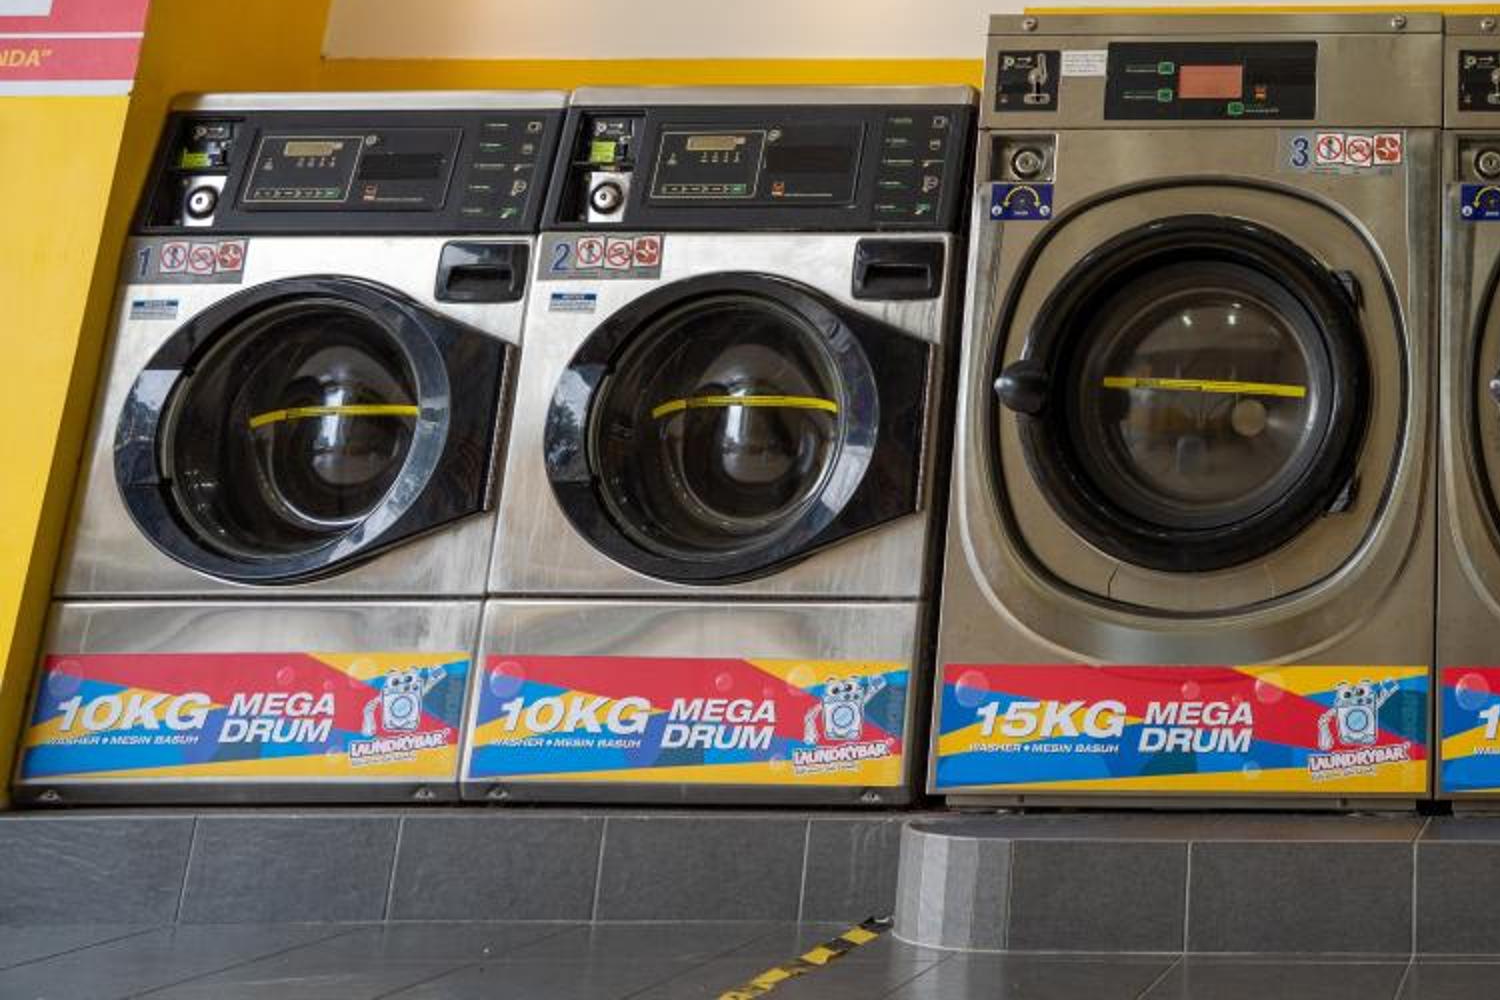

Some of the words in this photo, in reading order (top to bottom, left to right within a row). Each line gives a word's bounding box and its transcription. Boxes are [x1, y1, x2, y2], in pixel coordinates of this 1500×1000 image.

[1291, 137, 1310, 168] 3
[138, 247, 152, 276] 1
[551, 243, 570, 273] 2
[58, 693, 211, 732] 10KG
[229, 693, 336, 716] MEGA
[977, 700, 1127, 738] 15KG
[1145, 702, 1253, 726] MEGA
[219, 718, 335, 743] DRUM
[1139, 728, 1253, 753] DRUM
